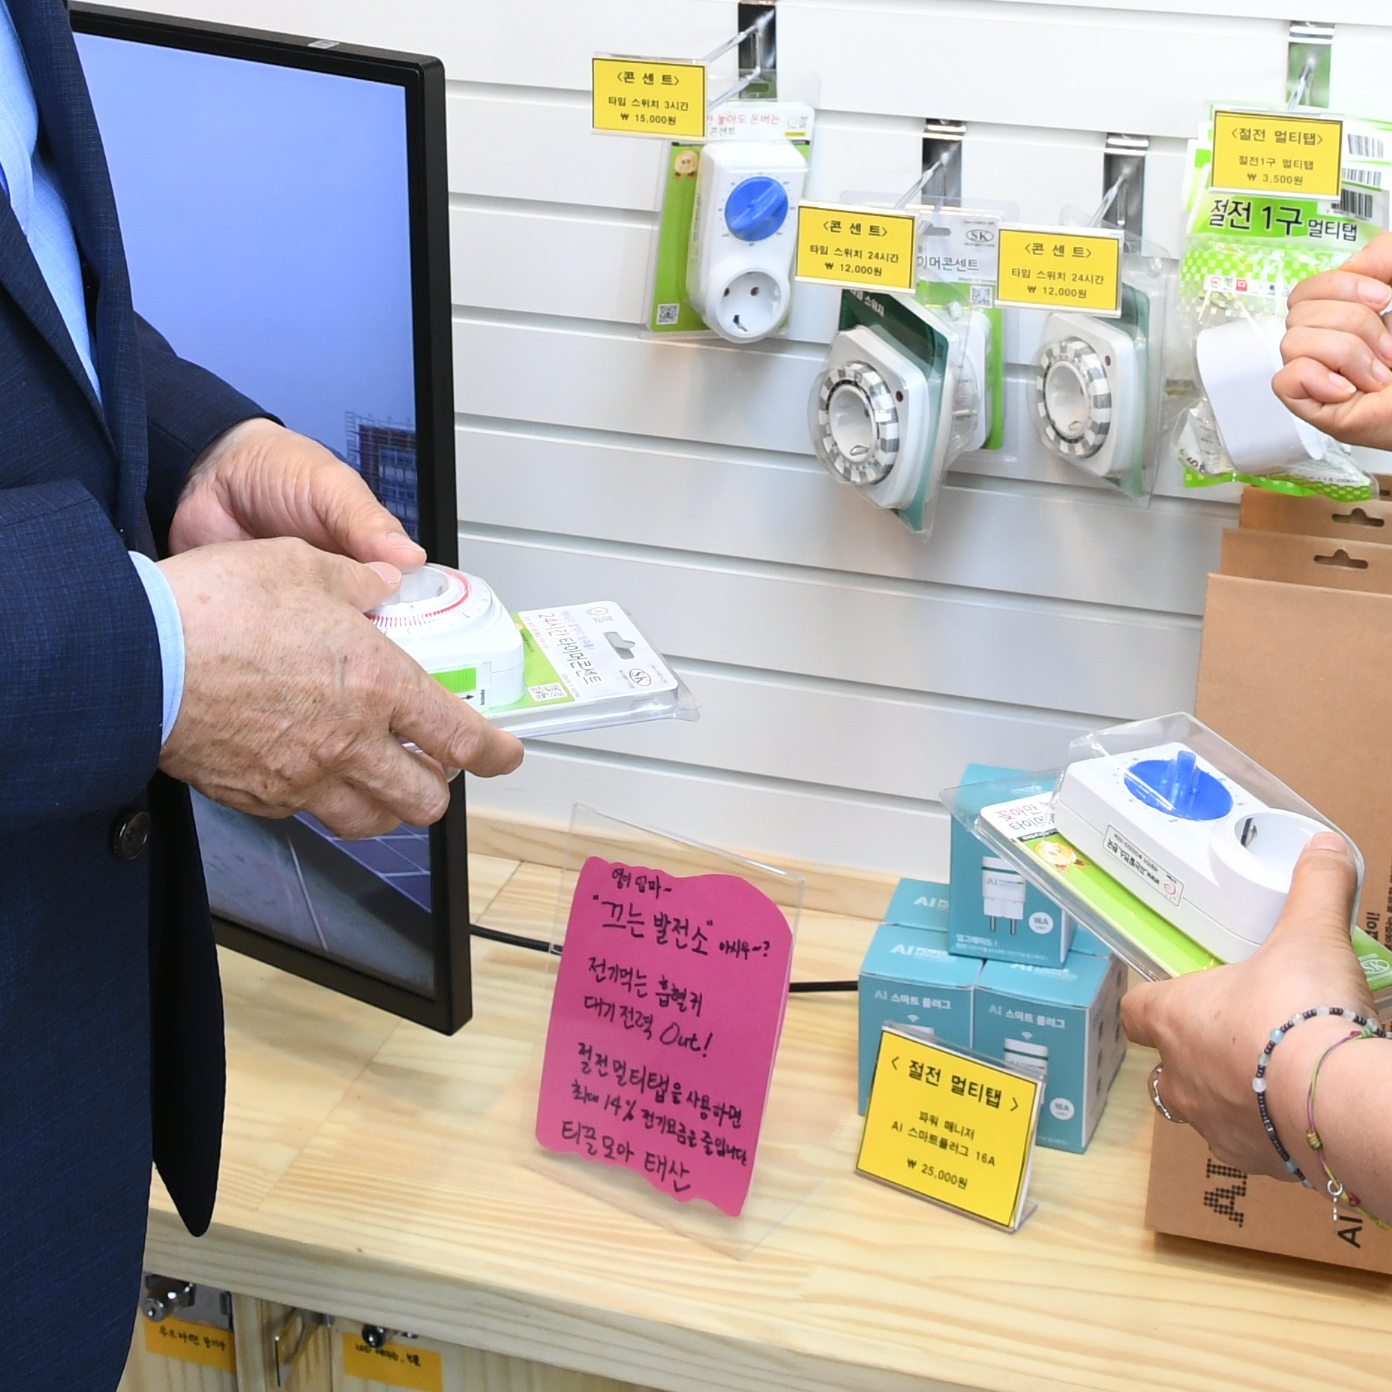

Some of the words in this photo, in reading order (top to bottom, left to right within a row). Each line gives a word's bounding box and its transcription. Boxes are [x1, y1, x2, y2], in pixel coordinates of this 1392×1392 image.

[608, 96, 626, 107] 타임
[631, 97, 659, 109] 스위치
[664, 99, 688, 111] 3시간
[635, 113, 676, 126] 15,000원
[1231, 127, 1266, 142] <절전
[1274, 129, 1323, 146] 멀티탭>
[1238, 155, 1276, 168] 절전1구
[1282, 157, 1314, 171] 멀티탭
[1263, 173, 1303, 186] 3,500원
[1208, 198, 1252, 231] 절전
[1261, 204, 1303, 236] 1구
[1308, 219, 1358, 242] 멀티탭
[809, 244, 828, 256] 타임
[833, 246, 863, 260] 스위치
[867, 250, 899, 263] 24시간
[917, 255, 979, 272] 이머콘센트
[839, 263, 882, 277] 12,000원
[1011, 267, 1030, 279] 타임
[1036, 269, 1066, 282] 스위치
[1071, 272, 1104, 285] 24시간
[1043, 286, 1087, 299] 12,000원
[557, 638, 602, 684] 타이머콘센트
[875, 990, 888, 1000] AI
[891, 993, 919, 1006] 스마트
[923, 996, 951, 1009] 플러그
[989, 1004, 1002, 1015] AI
[1005, 1009, 1034, 1023] 스마트
[1037, 1014, 1065, 1028] 플러그
[660, 1022, 713, 1058] Out!
[908, 1059, 941, 1087] 절전
[951, 1074, 1002, 1109] 멀티탭
[686, 1090, 742, 1129] 사용하면
[571, 1079, 599, 1104] 최대
[604, 1094, 637, 1122] 14%
[701, 1130, 748, 1167] 줄입니다
[919, 1111, 939, 1128] 파워
[944, 1120, 975, 1141] 매니저
[891, 1120, 903, 1133] AI
[907, 1127, 969, 1158] 스마트플러그
[975, 1150, 996, 1167] 16A
[644, 1151, 691, 1193] 태산
[921, 1164, 968, 1190] 25,000원
